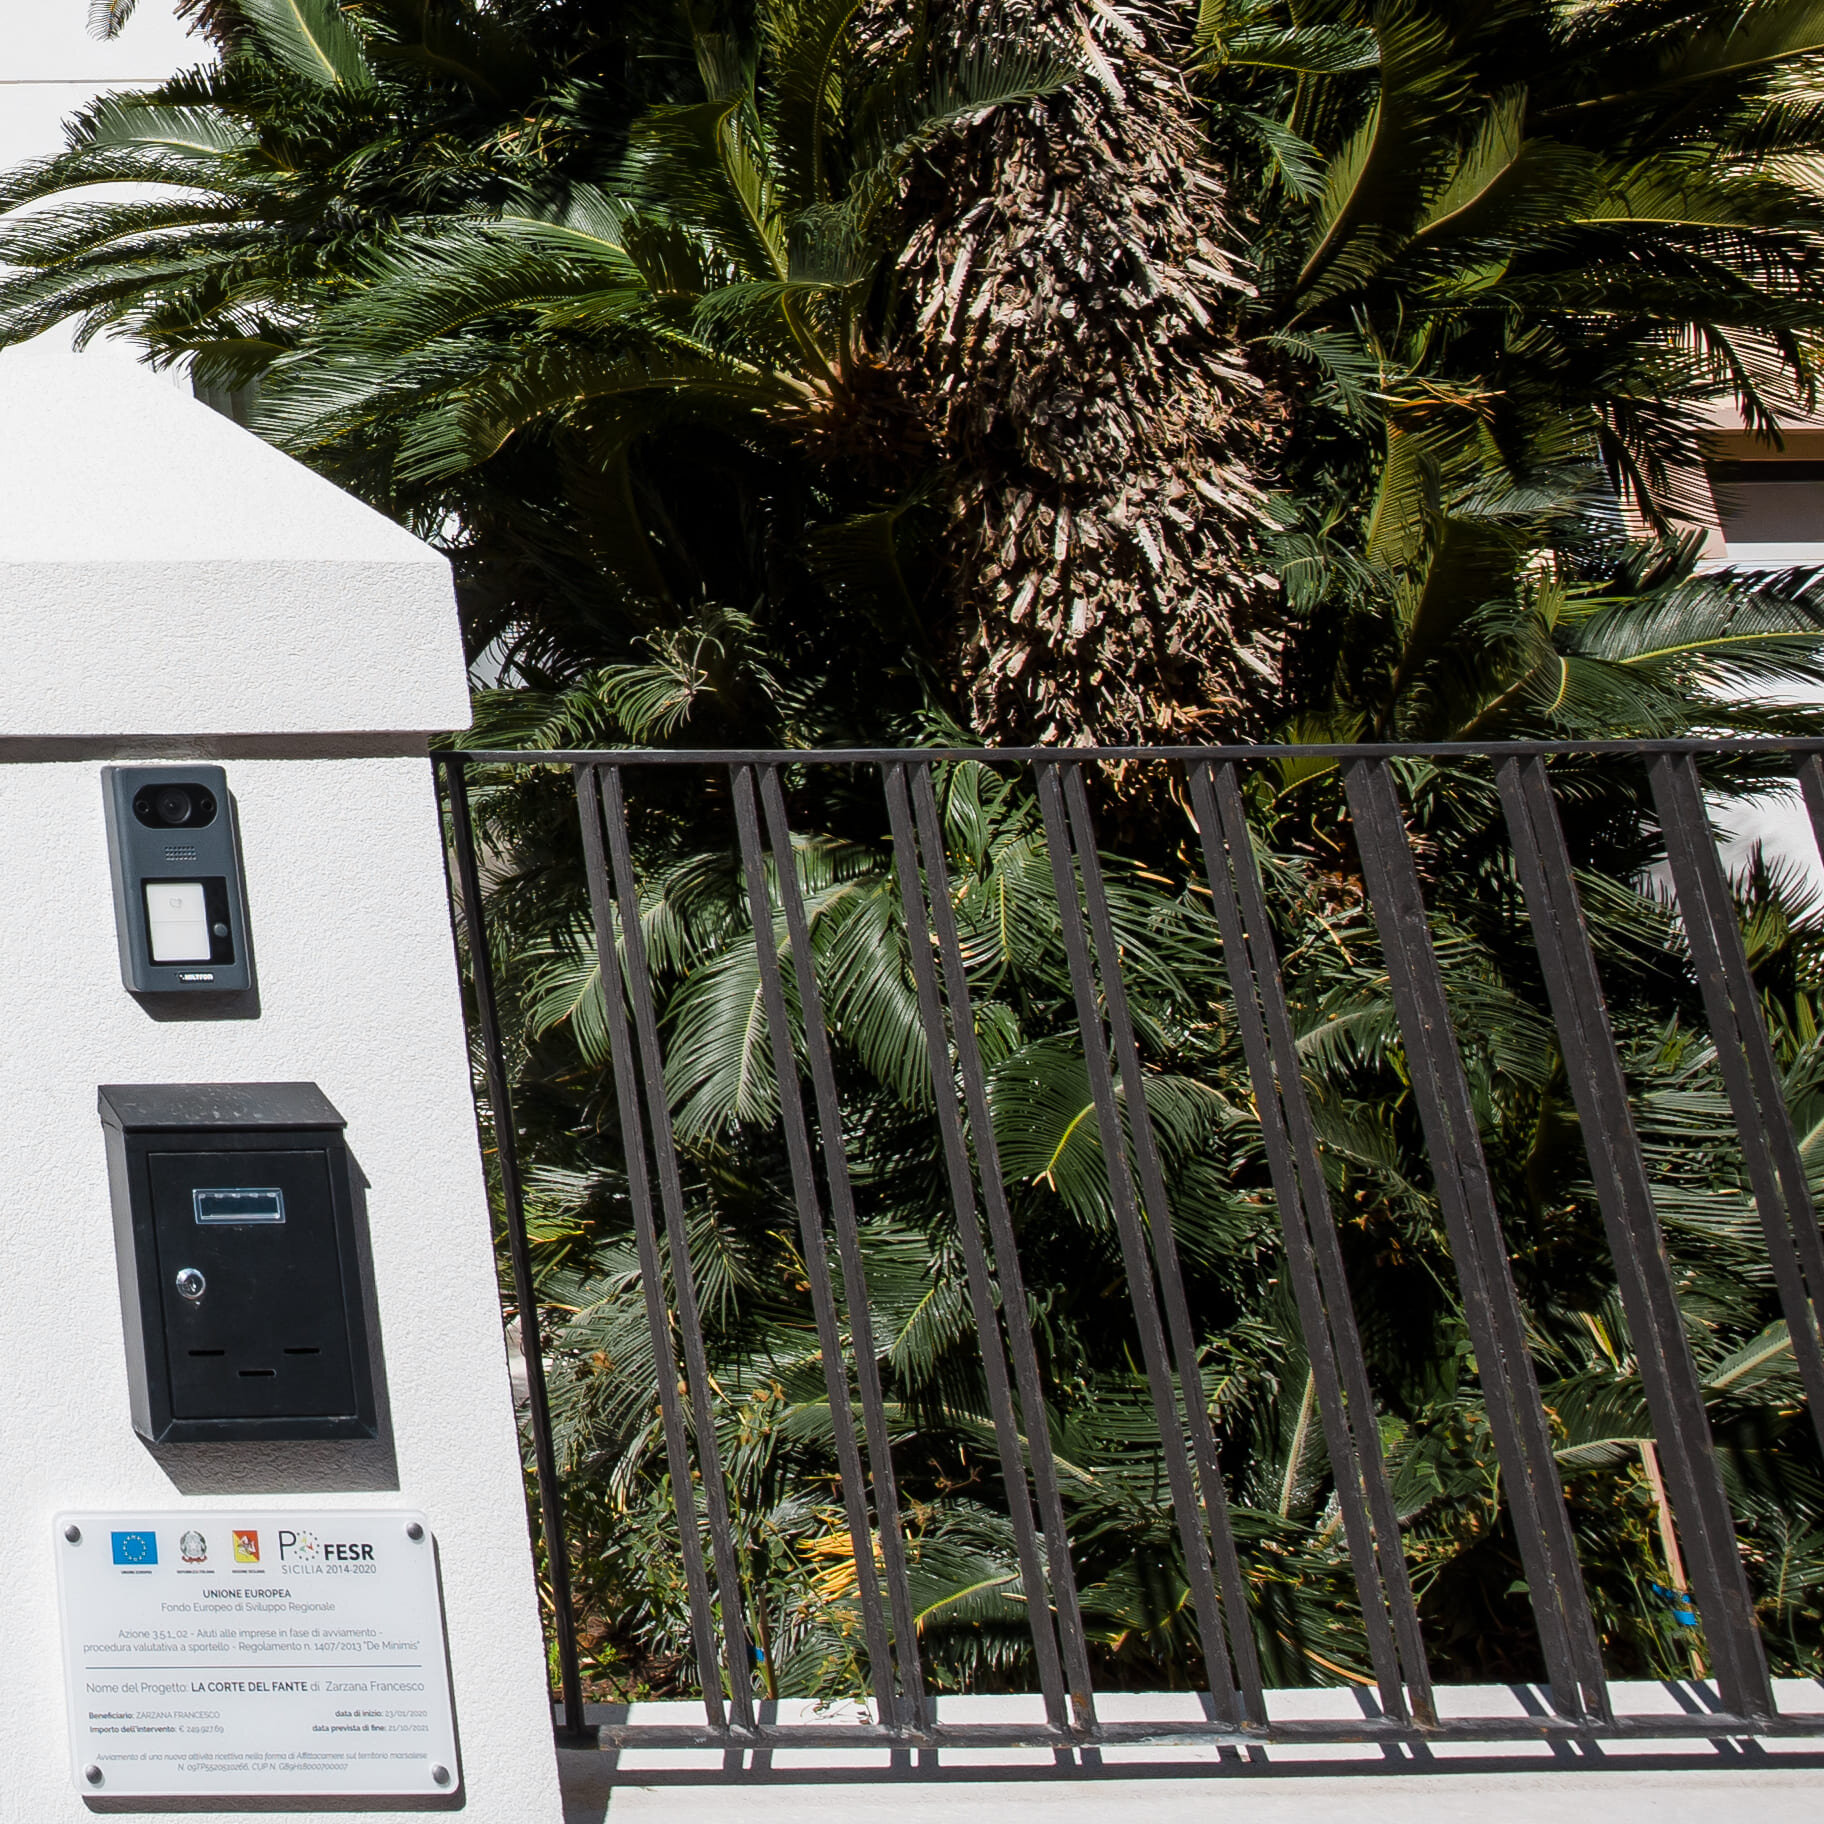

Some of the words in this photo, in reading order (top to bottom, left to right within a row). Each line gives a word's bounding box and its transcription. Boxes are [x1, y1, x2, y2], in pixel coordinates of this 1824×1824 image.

[323, 1543, 375, 1561] FESR
[281, 1564, 323, 1575] SICILIA
[326, 1564, 377, 1574] 2014-2020
[202, 1588, 242, 1598] UNIONE
[244, 1588, 292, 1598] EUROPEA
[161, 1602, 191, 1612] Fondo
[193, 1602, 233, 1614] Europeo
[234, 1601, 244, 1612] di
[245, 1601, 287, 1614] Sviluppo
[288, 1601, 336, 1614] Regionale
[118, 1629, 150, 1639] Azione
[196, 1629, 218, 1638] Aiuti
[219, 1628, 237, 1638] alle
[238, 1628, 277, 1640] imprese
[278, 1628, 287, 1637] in
[289, 1628, 309, 1637] fase
[311, 1628, 320, 1637] di
[322, 1628, 377, 1637] avviamento
[83, 1642, 131, 1654] procedura
[133, 1642, 178, 1651] valutativa
[188, 1642, 230, 1653] sportello
[238, 1641, 302, 1653] Regolamento
[314, 1641, 362, 1652] 1407/2013
[86, 1683, 119, 1693] Nome
[121, 1682, 138, 1692] del
[191, 1682, 206, 1692] LA
[207, 1682, 245, 1692] CORTE
[248, 1681, 270, 1692] DEL
[272, 1681, 308, 1692] FANTE
[310, 1681, 320, 1691] di
[325, 1681, 368, 1692] Zarzana
[370, 1681, 425, 1691] Francesco
[136, 1711, 173, 1719] ZARZANA
[173, 1711, 220, 1719] FRANCESCO
[335, 1709, 352, 1717] data
[353, 1709, 360, 1717] di
[89, 1725, 119, 1735] Importo
[331, 1724, 361, 1734] prevista
[362, 1724, 369, 1732] di
